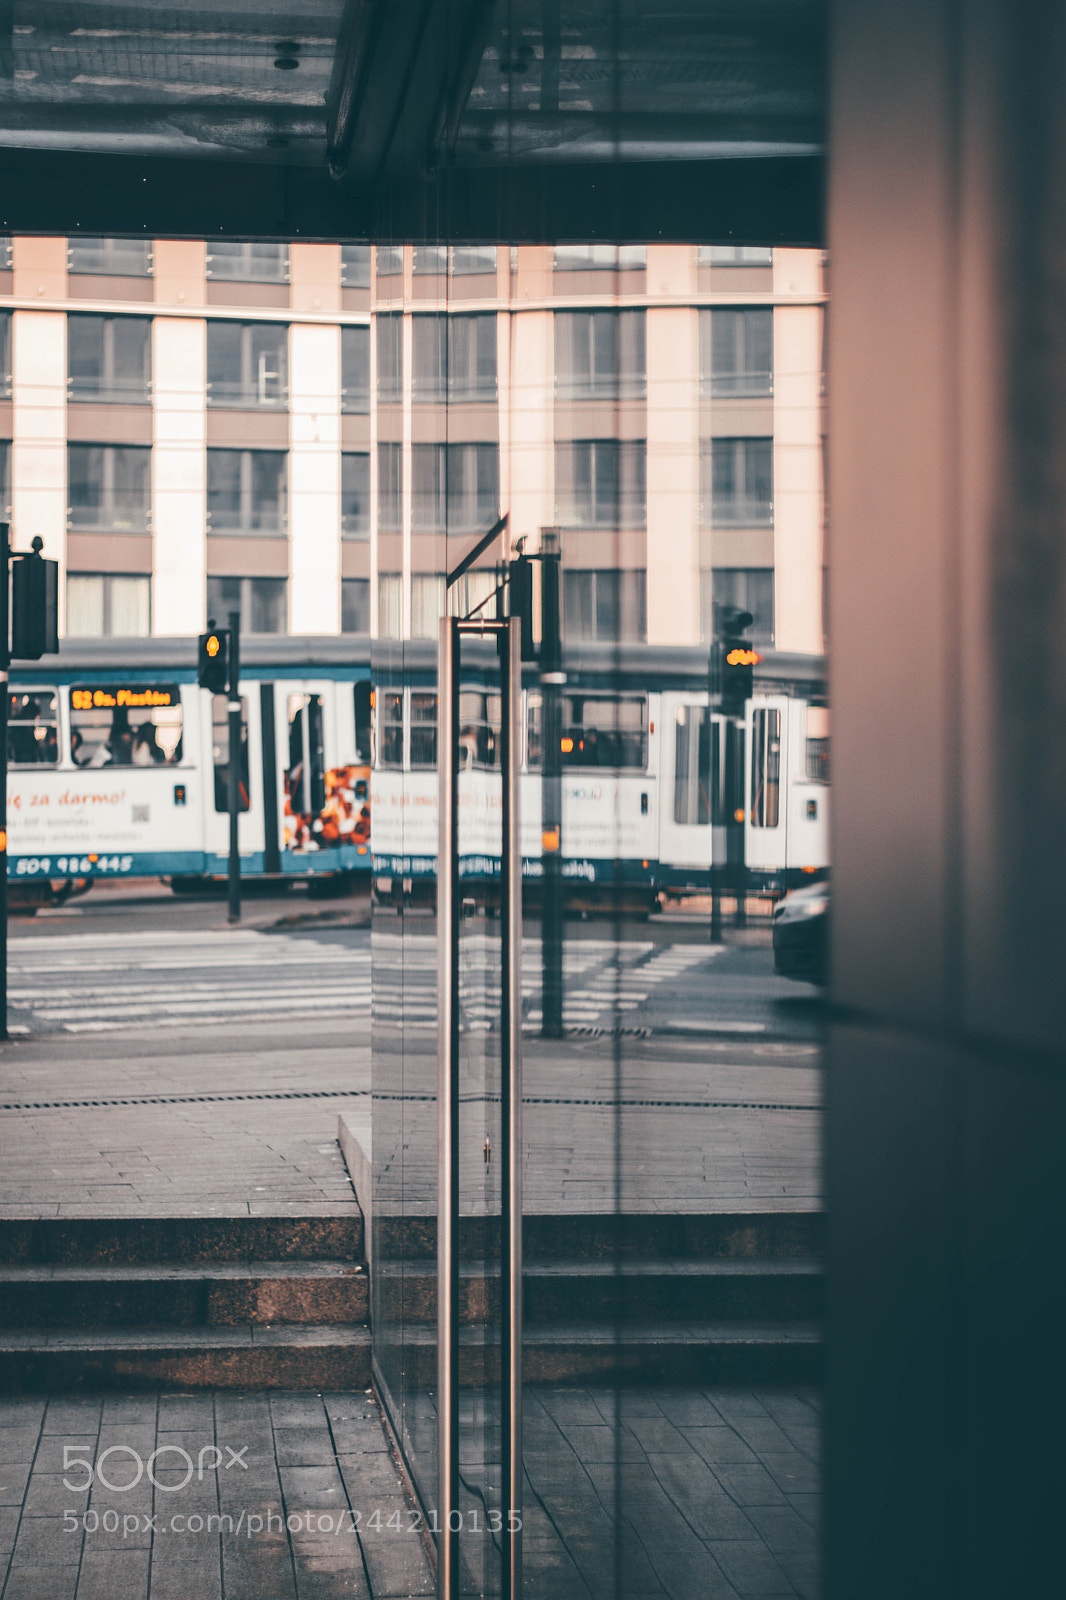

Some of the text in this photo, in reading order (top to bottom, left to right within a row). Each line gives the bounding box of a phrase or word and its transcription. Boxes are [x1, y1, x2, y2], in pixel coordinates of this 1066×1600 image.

[30, 795, 49, 806] za
[58, 789, 126, 805] darmo!
[16, 858, 51, 875] 509
[97, 856, 133, 873] 445
